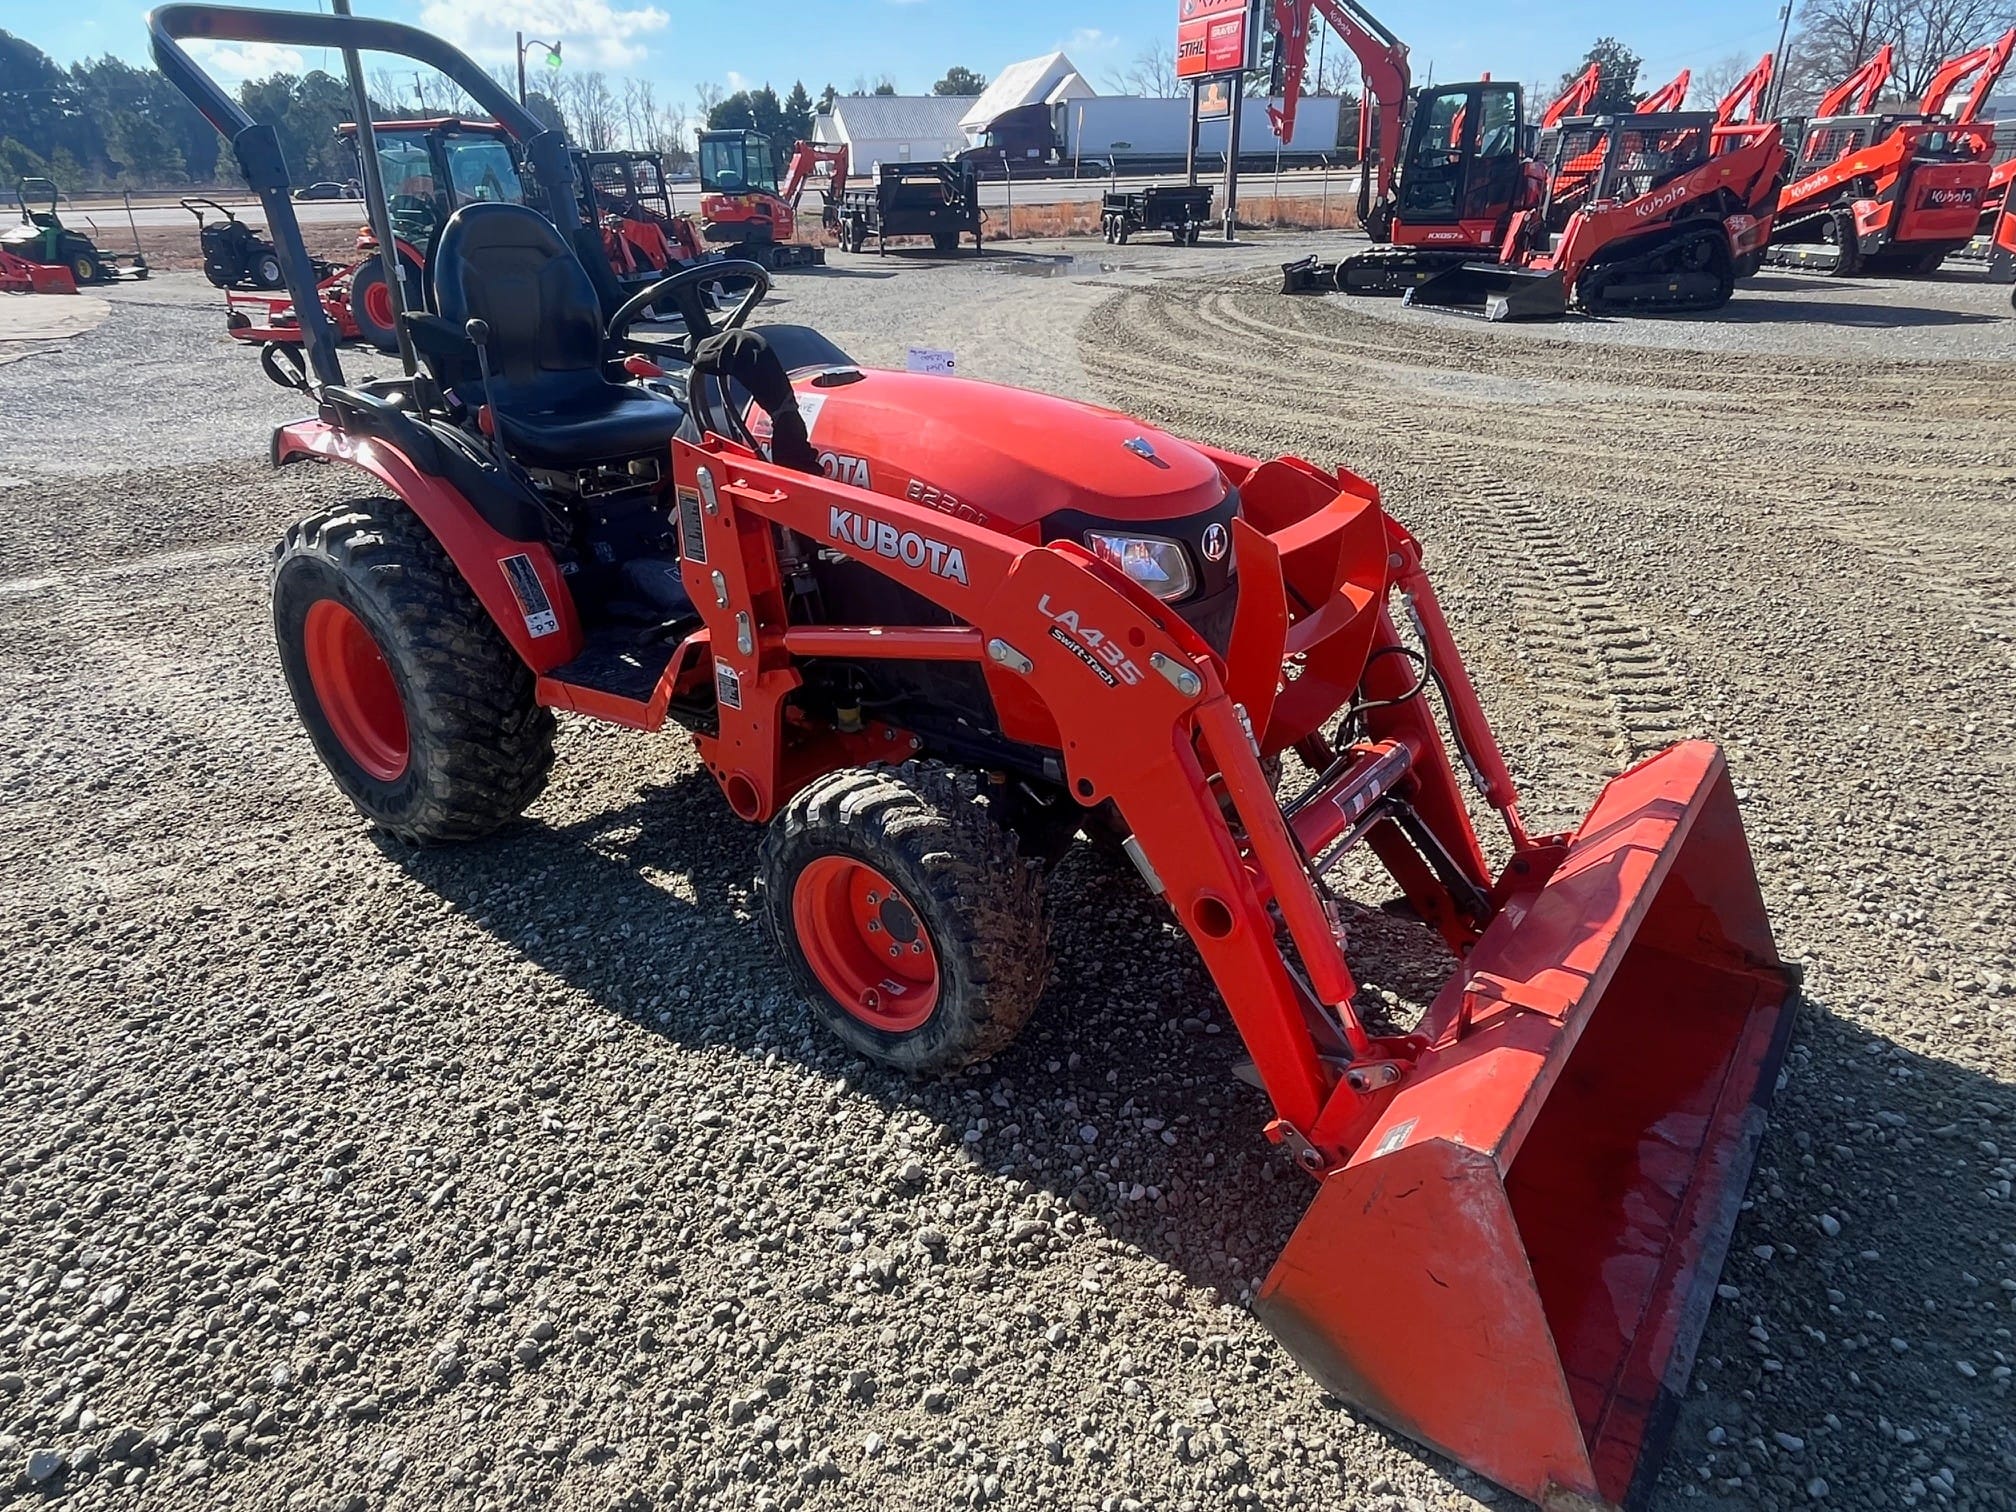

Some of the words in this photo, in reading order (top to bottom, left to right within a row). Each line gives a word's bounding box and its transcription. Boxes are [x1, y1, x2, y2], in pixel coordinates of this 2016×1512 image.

[1178, 39, 1206, 58] STIHL
[1635, 185, 1686, 217] Kubota
[1791, 174, 1828, 198] Kubota
[1932, 190, 1972, 203] Kubota
[828, 505, 970, 587] KUBOTA
[1038, 593, 1145, 685] LA435
[1051, 628, 1114, 685] Swift-Tach
